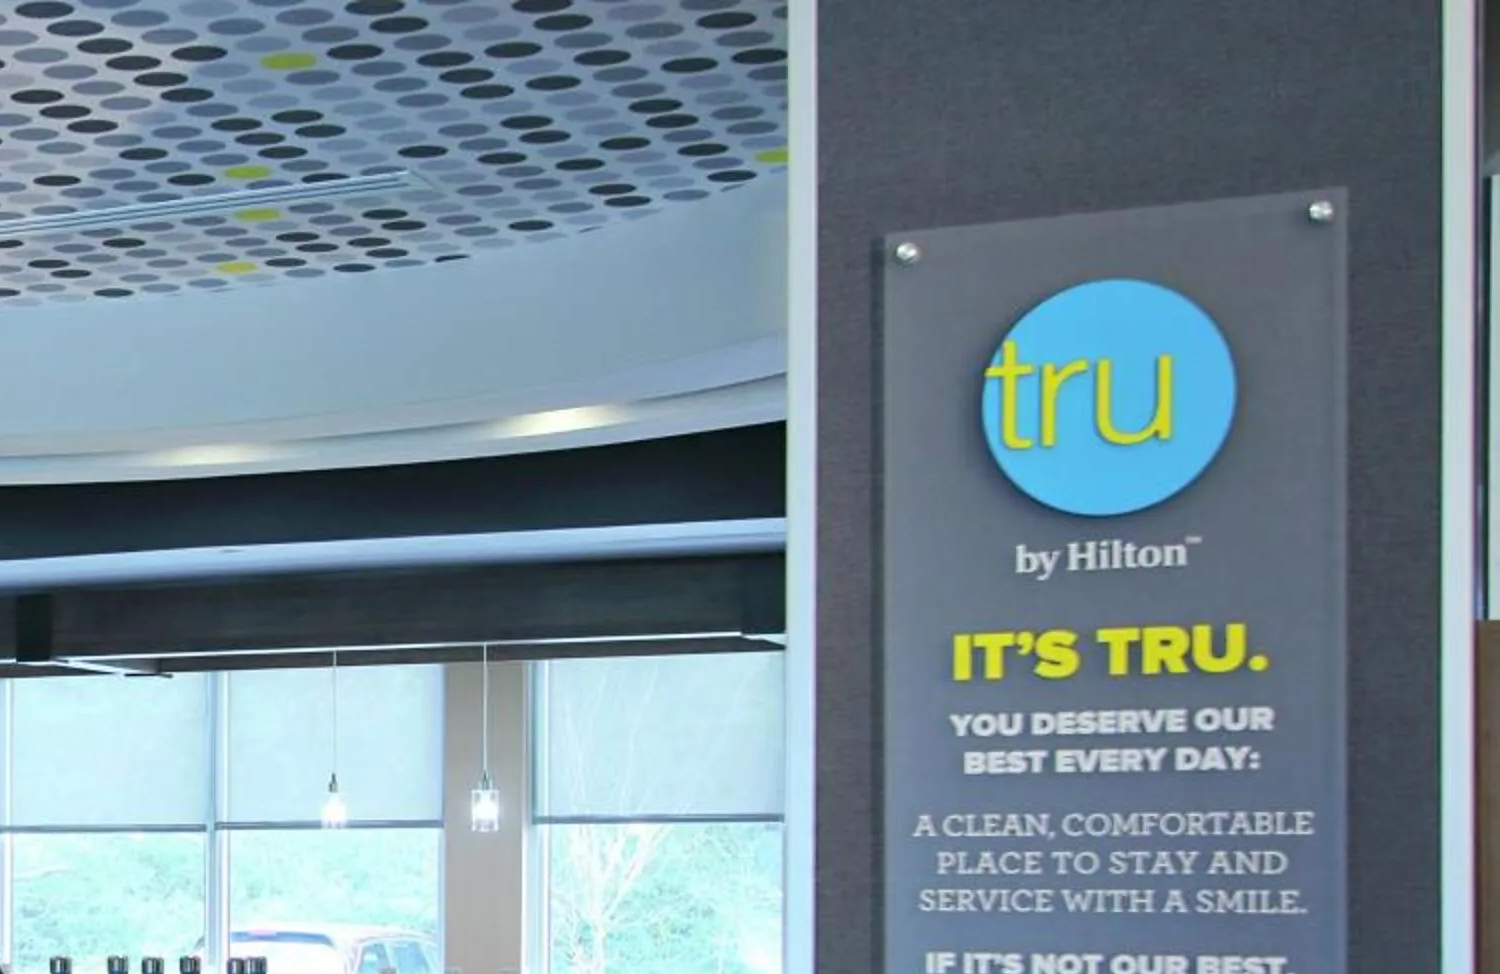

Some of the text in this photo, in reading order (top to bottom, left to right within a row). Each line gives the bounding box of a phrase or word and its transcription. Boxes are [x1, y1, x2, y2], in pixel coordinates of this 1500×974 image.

[984, 339, 1174, 450] tru
[1016, 544, 1061, 580] by
[953, 624, 1269, 680] IT'S TRU.
[950, 707, 1275, 737] YOU DESERVE OUR
[963, 746, 1261, 775] BEST EVERY DAY:
[912, 811, 1314, 839] A CLEAN, COMFORTABLE
[936, 850, 1288, 876] PLACE TO STAY AND
[919, 889, 1309, 914] SERVICE WITH A SMILE.
[925, 952, 957, 974] IF
